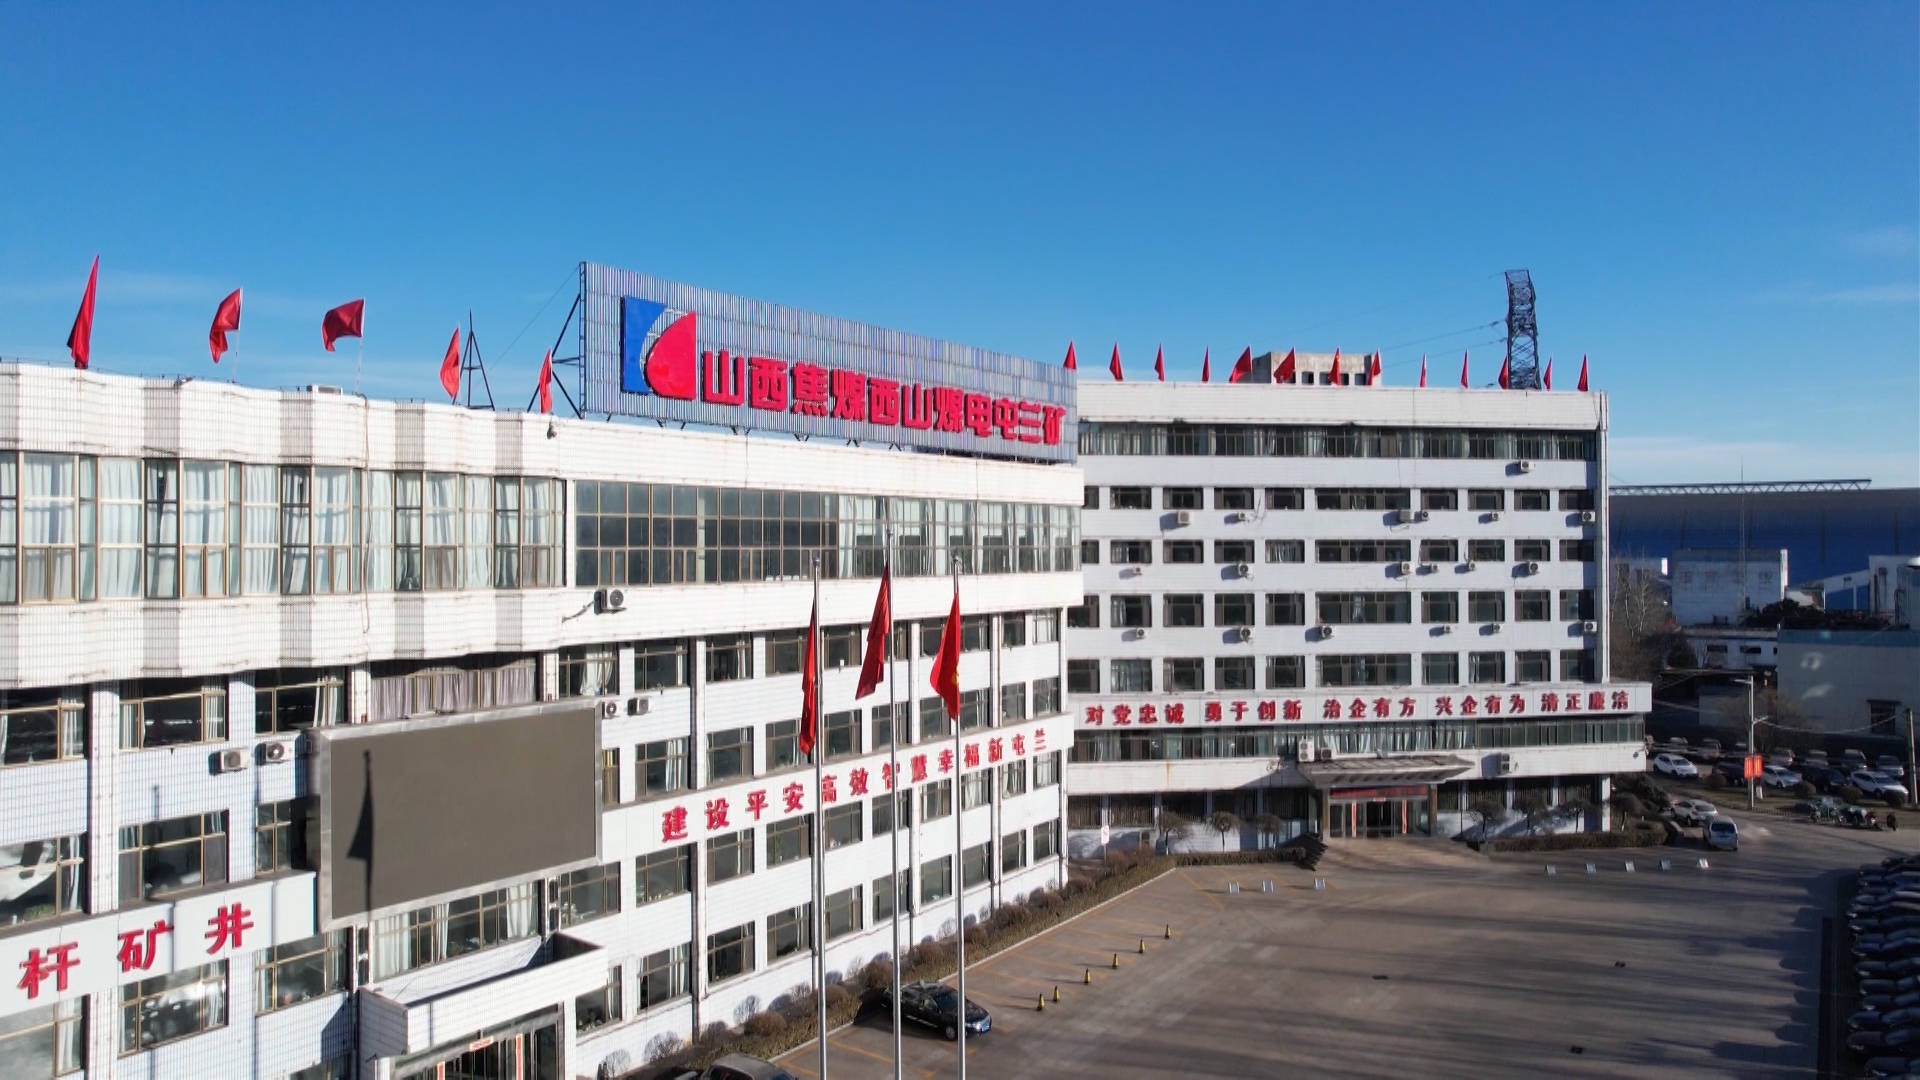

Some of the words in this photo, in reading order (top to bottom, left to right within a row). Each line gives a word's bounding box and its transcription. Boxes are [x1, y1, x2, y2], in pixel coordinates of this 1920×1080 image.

[1085, 702, 1185, 727] 对党忠诚
[1205, 699, 1303, 723] 勇于创新
[1323, 697, 1416, 720] 治企有方
[1435, 694, 1526, 716] 兴企有为
[17, 901, 255, 999] 杆矿井
